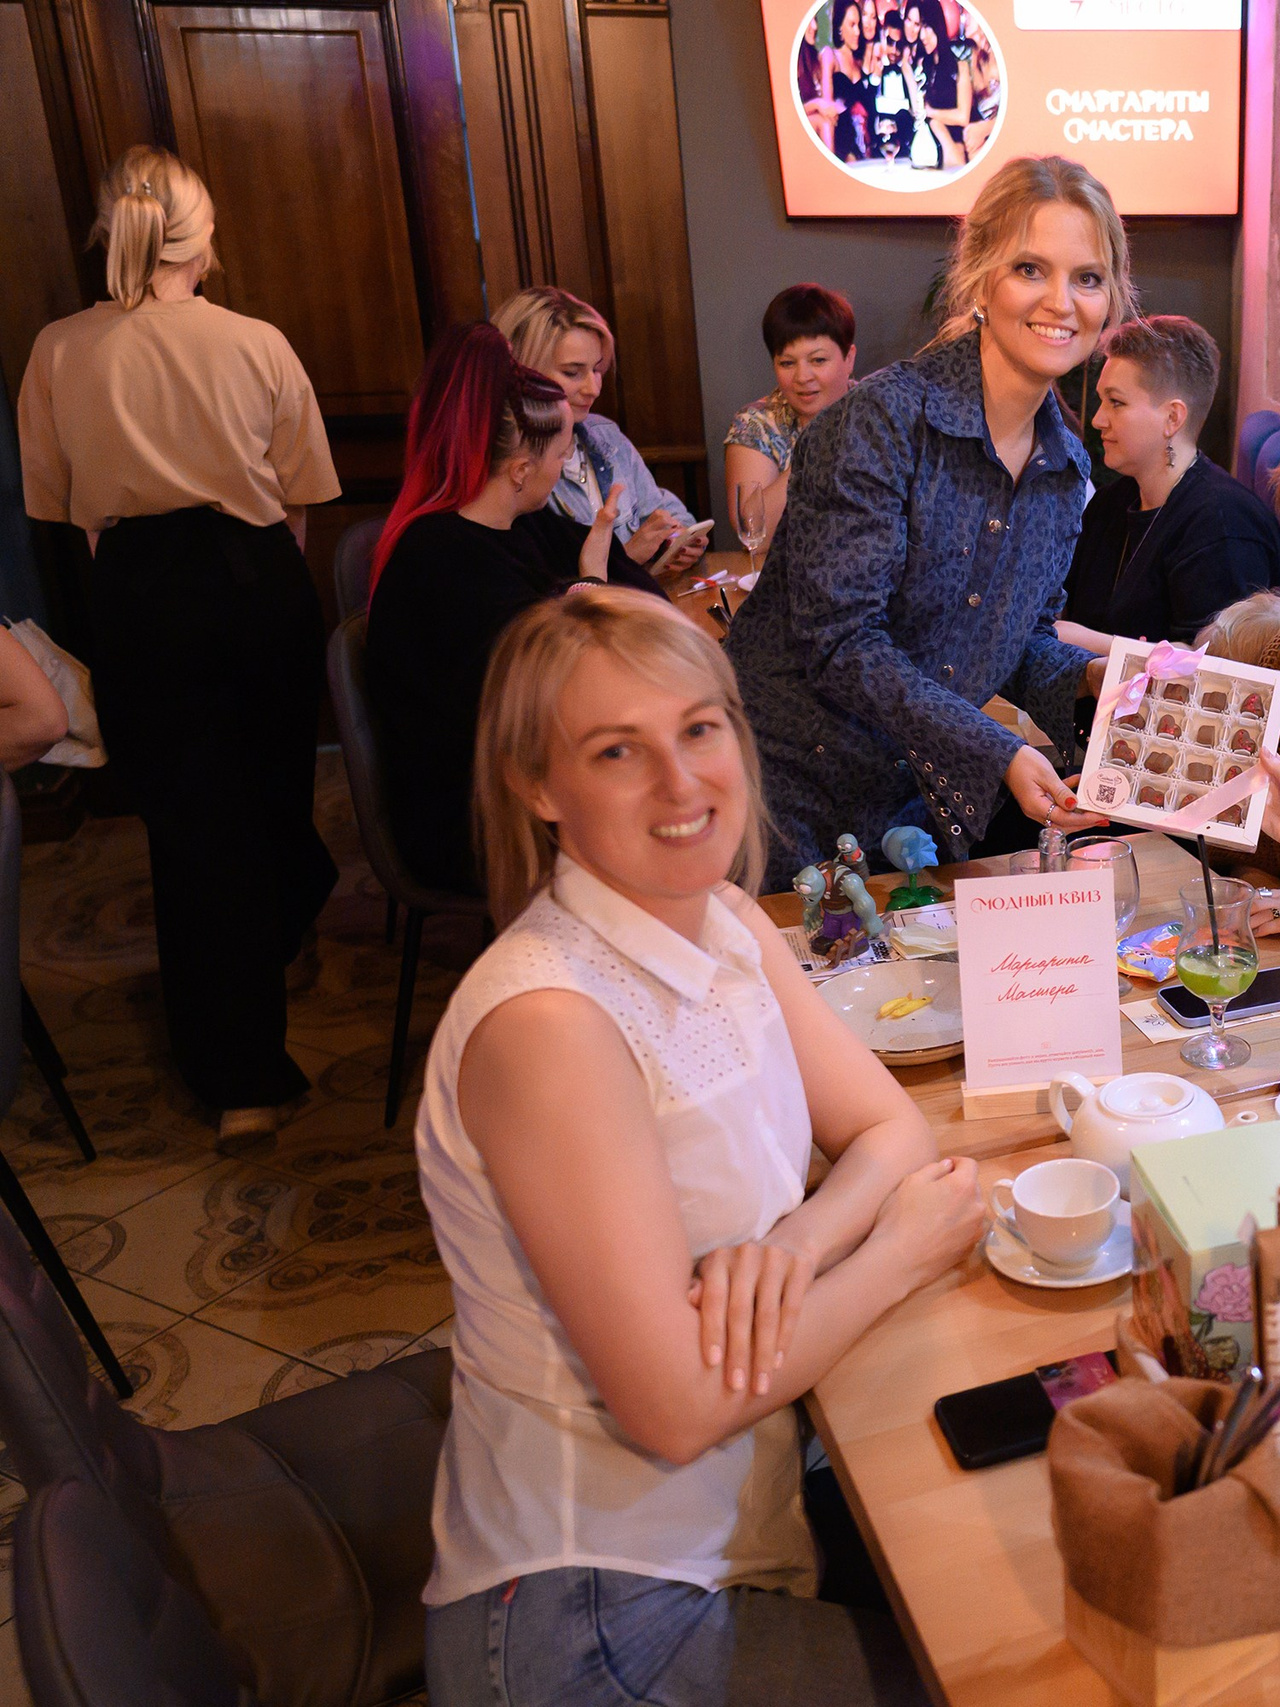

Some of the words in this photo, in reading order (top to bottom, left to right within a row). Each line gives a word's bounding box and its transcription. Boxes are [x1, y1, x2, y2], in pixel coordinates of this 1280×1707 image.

[1046, 88, 1209, 115] МАРГАРИТЫ
[1063, 117, 1194, 144] МАСТЕРА
[970, 892, 1053, 914] МОДНЫЙ
[1059, 890, 1101, 905] КВИЗ
[998, 981, 1078, 1004] Мастера
